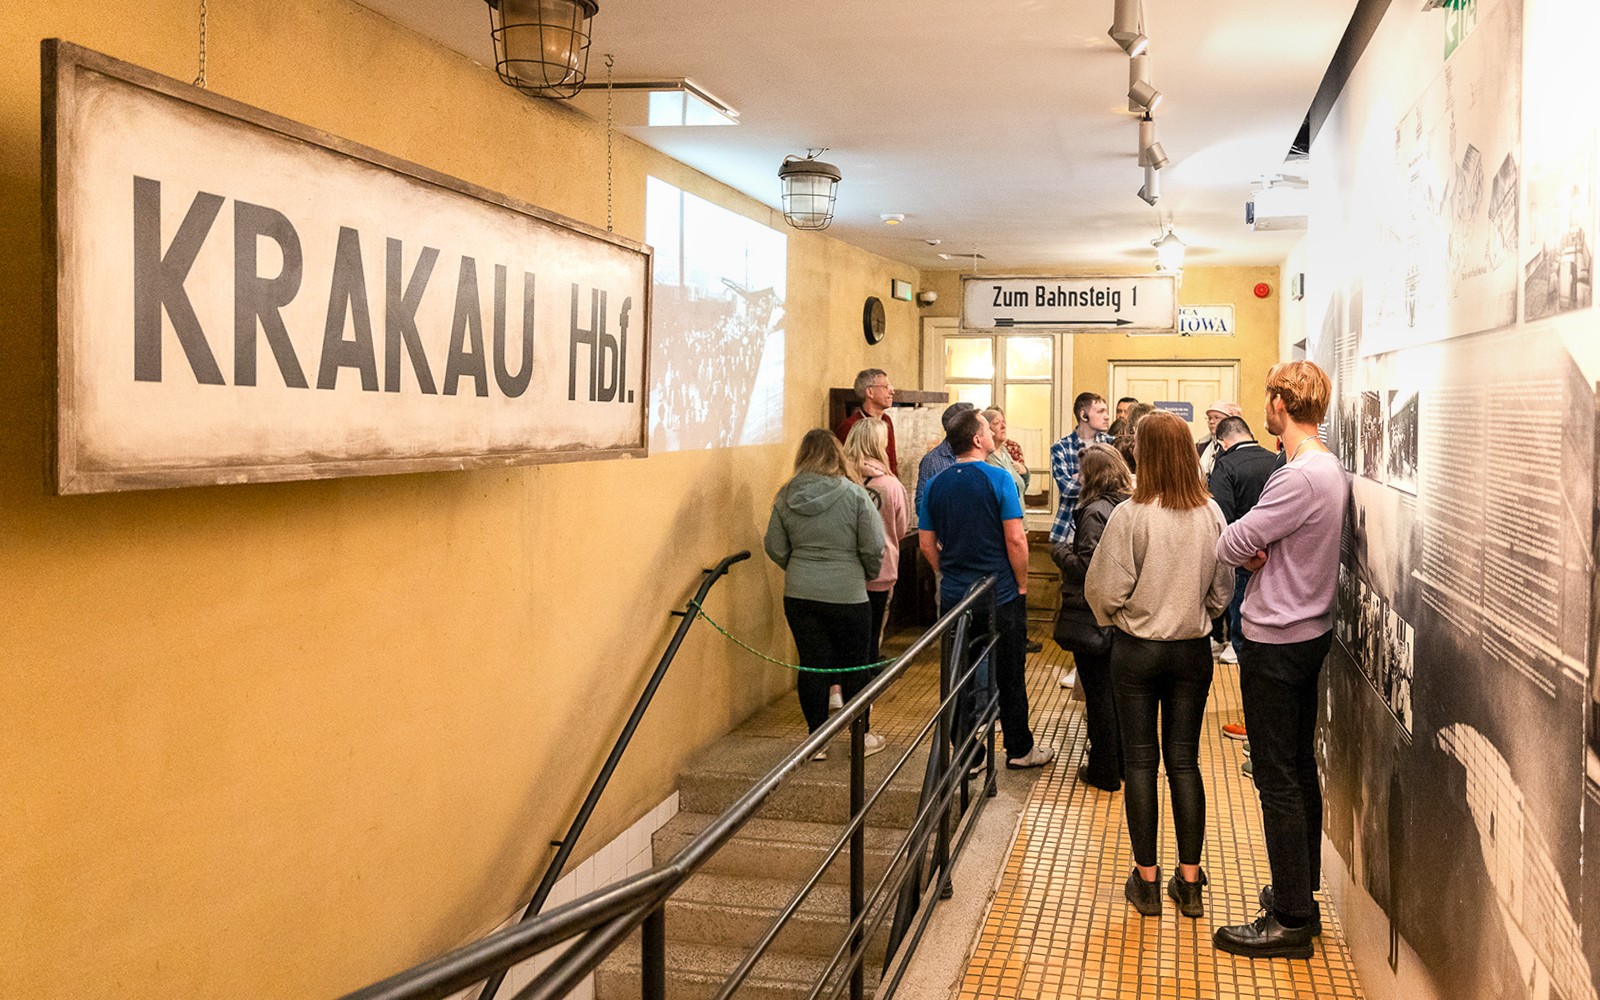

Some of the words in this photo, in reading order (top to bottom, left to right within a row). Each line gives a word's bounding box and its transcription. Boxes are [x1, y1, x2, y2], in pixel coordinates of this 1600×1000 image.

[133, 175, 535, 398] KRAKAU
[568, 282, 634, 404] Hbf.
[993, 286, 1029, 307] Zum
[1036, 285, 1121, 312] Bahnsteig
[1131, 285, 1137, 307] 1
[1178, 308, 1198, 316] ICA
